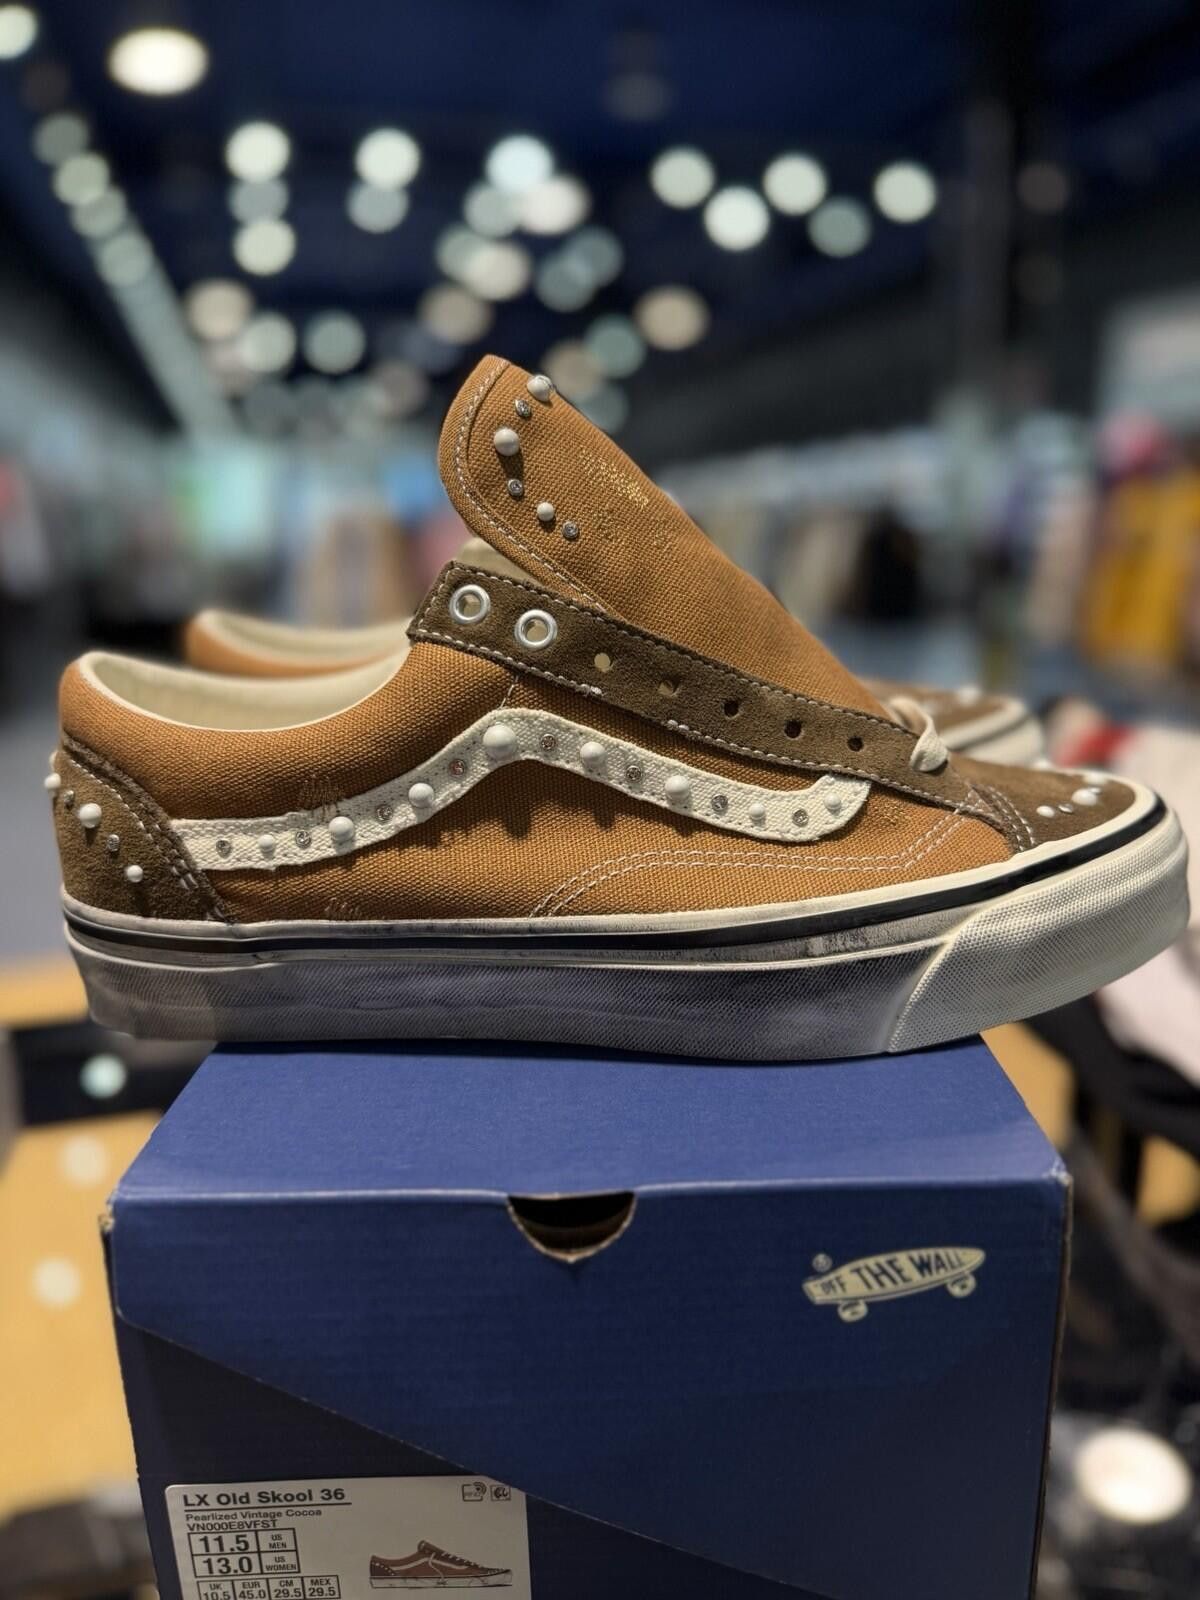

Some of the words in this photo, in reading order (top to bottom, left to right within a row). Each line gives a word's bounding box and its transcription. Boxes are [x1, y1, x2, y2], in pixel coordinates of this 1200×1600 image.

[851, 1257, 912, 1291] THE
[183, 1493, 210, 1507] LX
[216, 1492, 250, 1506] Old
[257, 1489, 313, 1504] Skool
[320, 1488, 346, 1501] 36
[185, 1512, 238, 1522] Pearlized
[240, 1509, 283, 1520] Vintage
[285, 1508, 322, 1518] Cocoa
[186, 1519, 279, 1532] VN000E8VFST
[199, 1534, 250, 1553] 11.5
[271, 1533, 283, 1541] US
[202, 1556, 253, 1575] 13.0
[274, 1555, 286, 1563] US
[265, 1563, 297, 1571] WOMEN
[242, 1581, 261, 1589] EUR
[310, 1578, 331, 1586] MEX
[238, 1589, 267, 1600] 45.0
[274, 1587, 302, 1598] 29.5
[308, 1587, 336, 1597] 29.5
